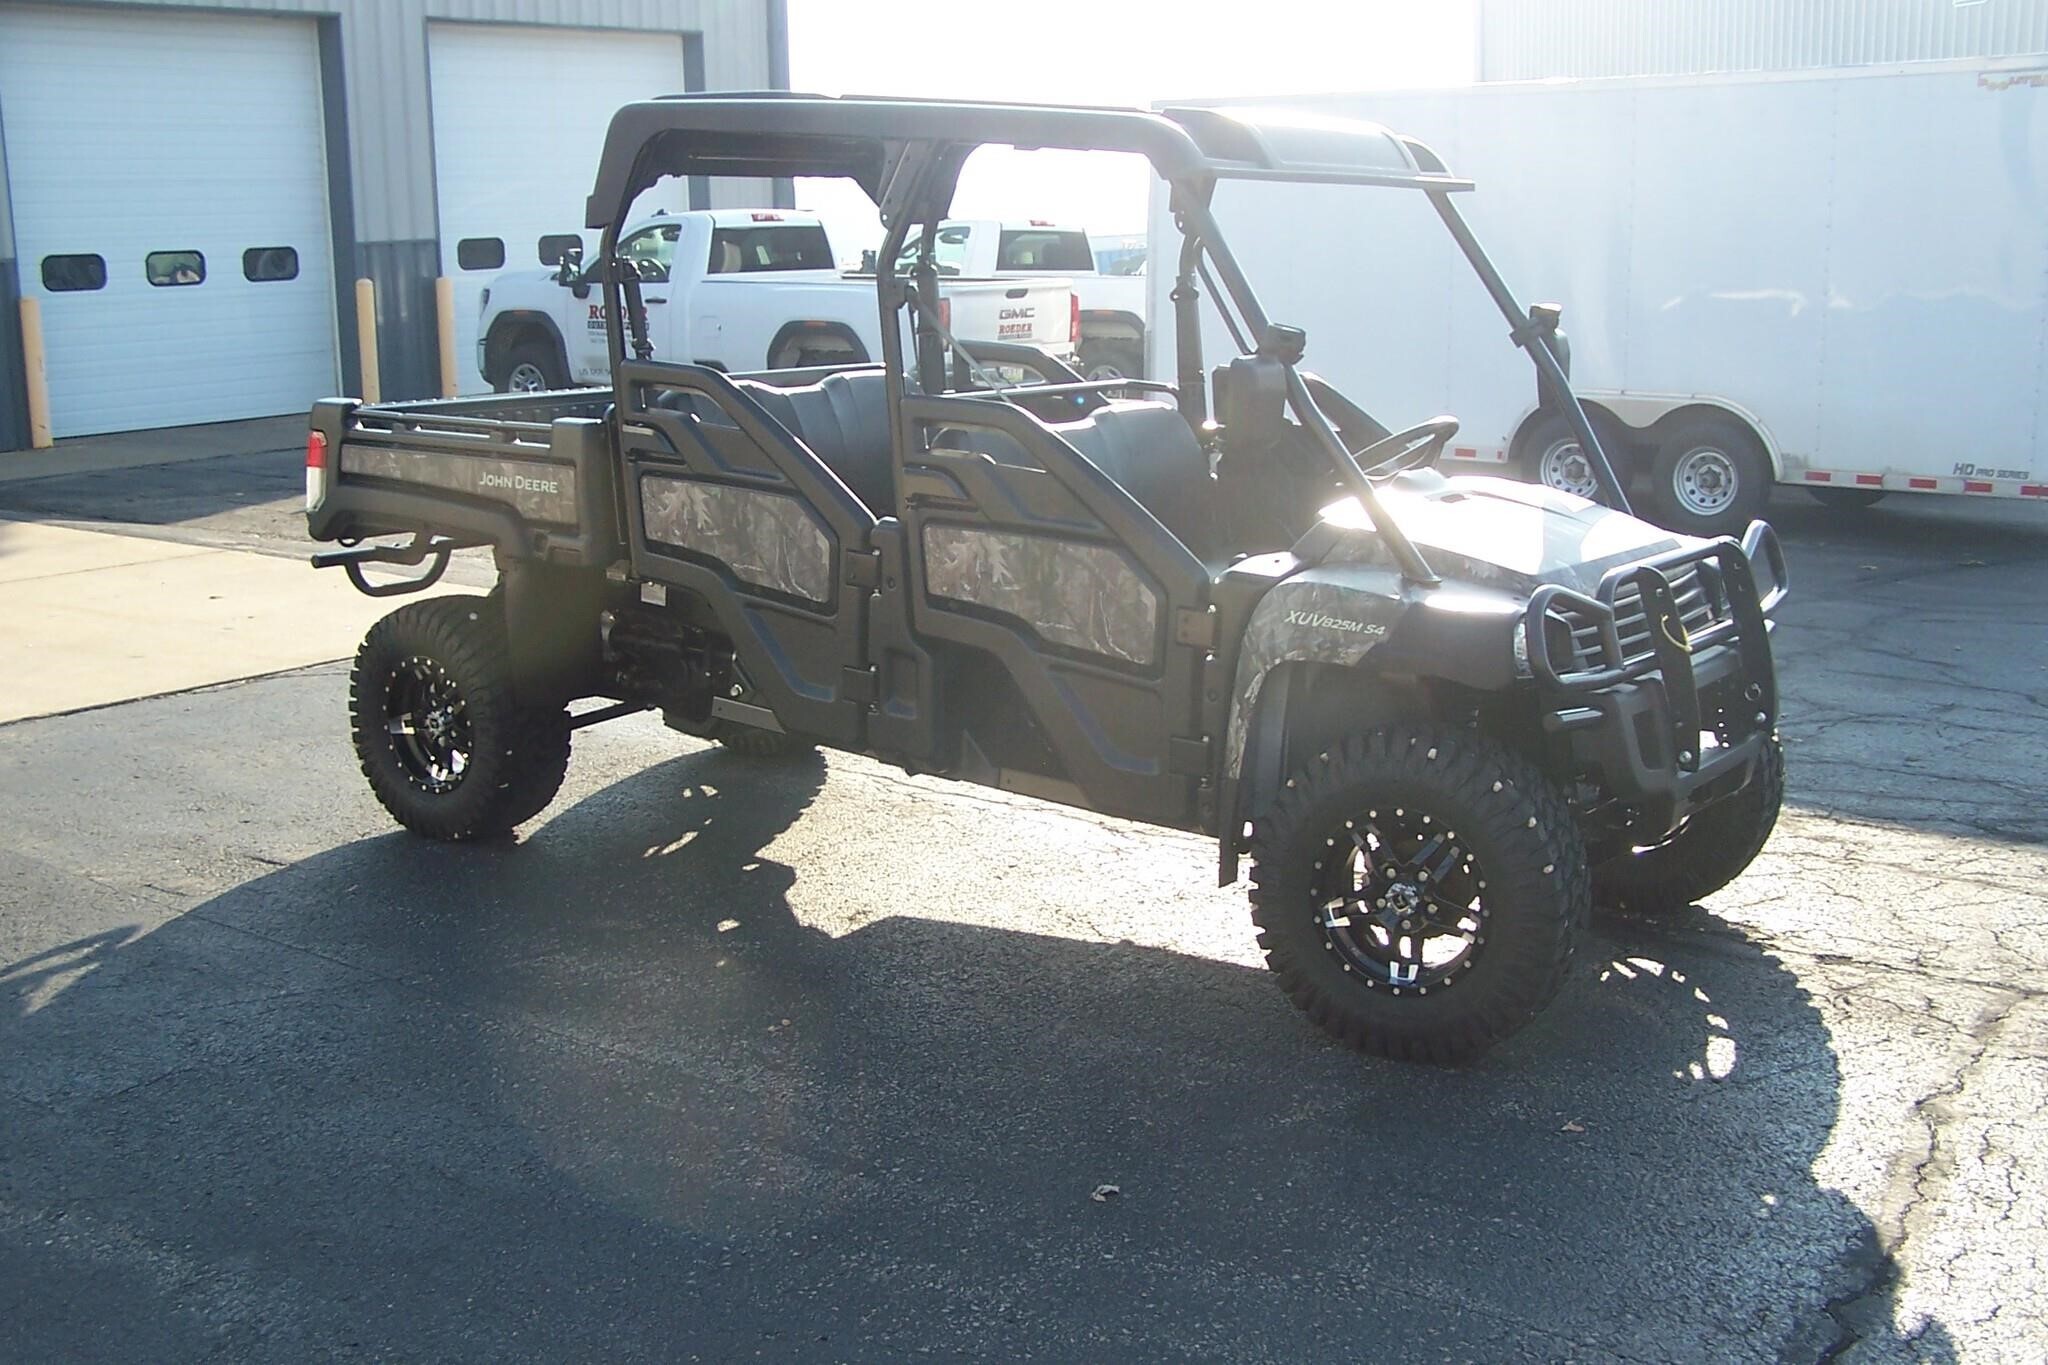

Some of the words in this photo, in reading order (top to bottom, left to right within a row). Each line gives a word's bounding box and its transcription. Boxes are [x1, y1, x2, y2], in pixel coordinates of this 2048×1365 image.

[999, 307, 1035, 320] GMC
[999, 323, 1032, 334] ROEDER
[1953, 462, 1975, 476] HD
[479, 471, 513, 489] JOHN
[514, 475, 559, 494] DEERE
[1283, 609, 1364, 633] XUV825M
[1363, 623, 1387, 636] S4
